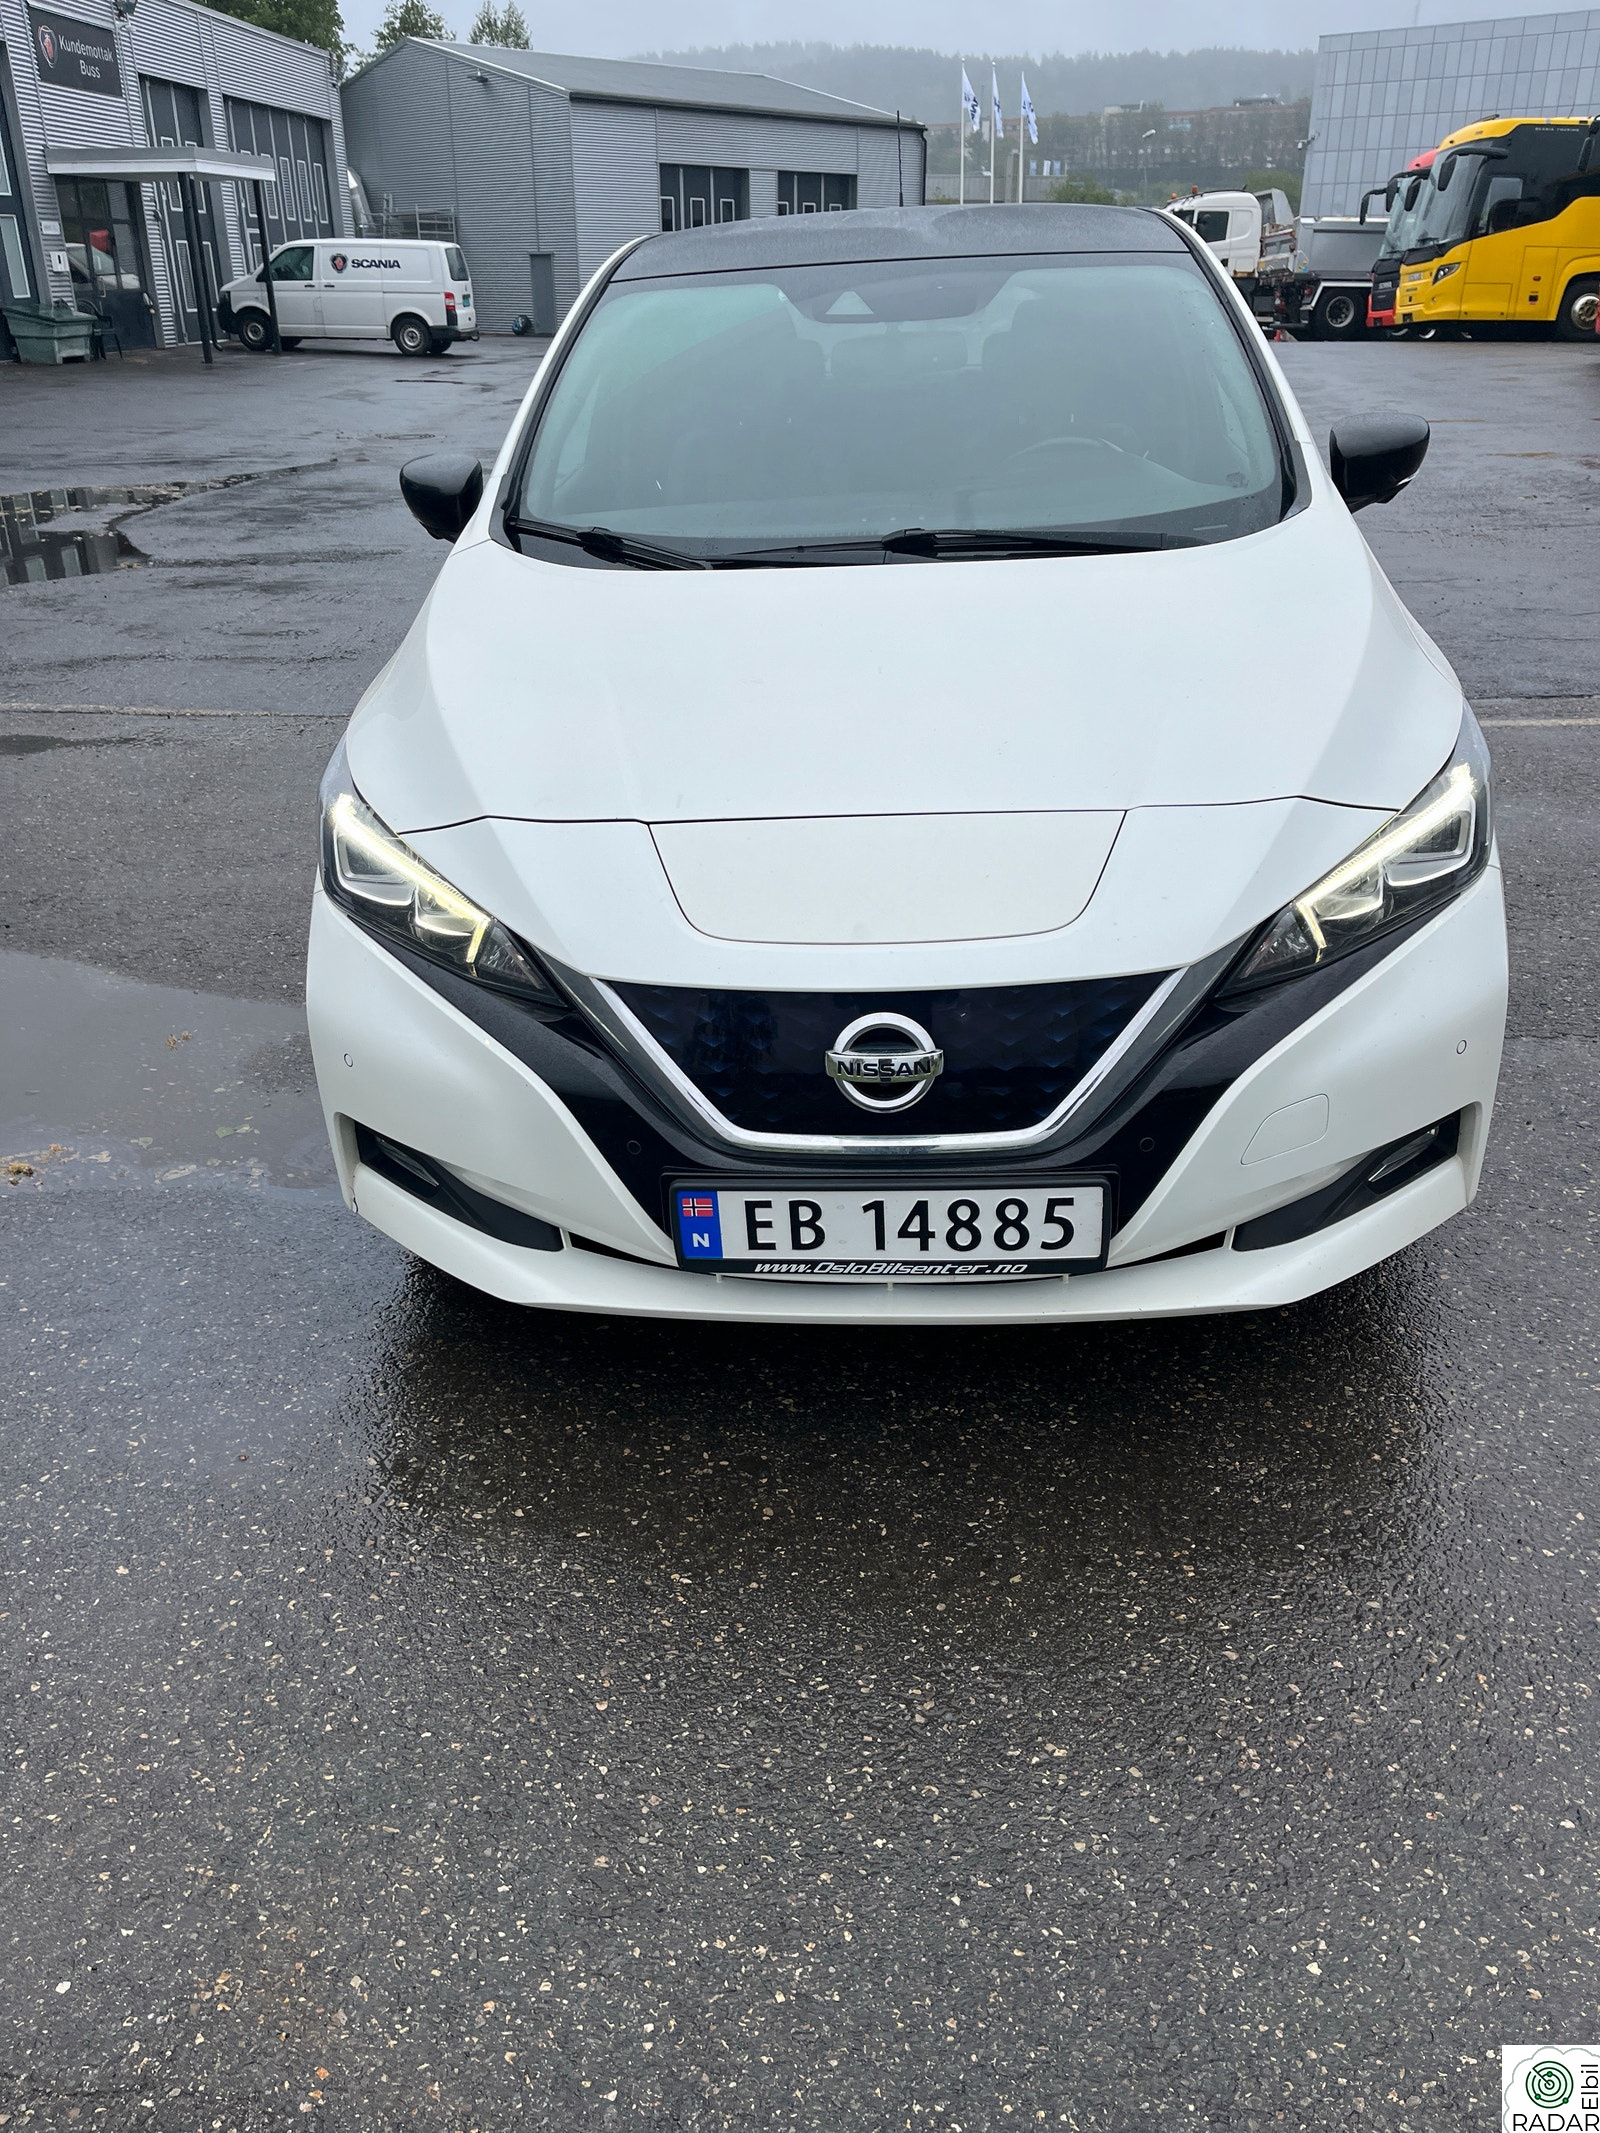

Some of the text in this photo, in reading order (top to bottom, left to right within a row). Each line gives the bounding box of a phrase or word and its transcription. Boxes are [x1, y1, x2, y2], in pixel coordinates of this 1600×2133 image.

[58, 34, 114, 62] Kundemottak
[79, 60, 101, 79] Buss
[351, 258, 402, 269] SCANIA
[837, 1060, 931, 1077] NISSAN
[744, 1197, 1075, 1252] EB 14885
[692, 1232, 710, 1248] N
[754, 1261, 1028, 1275] www.OsloBilsenter.no
